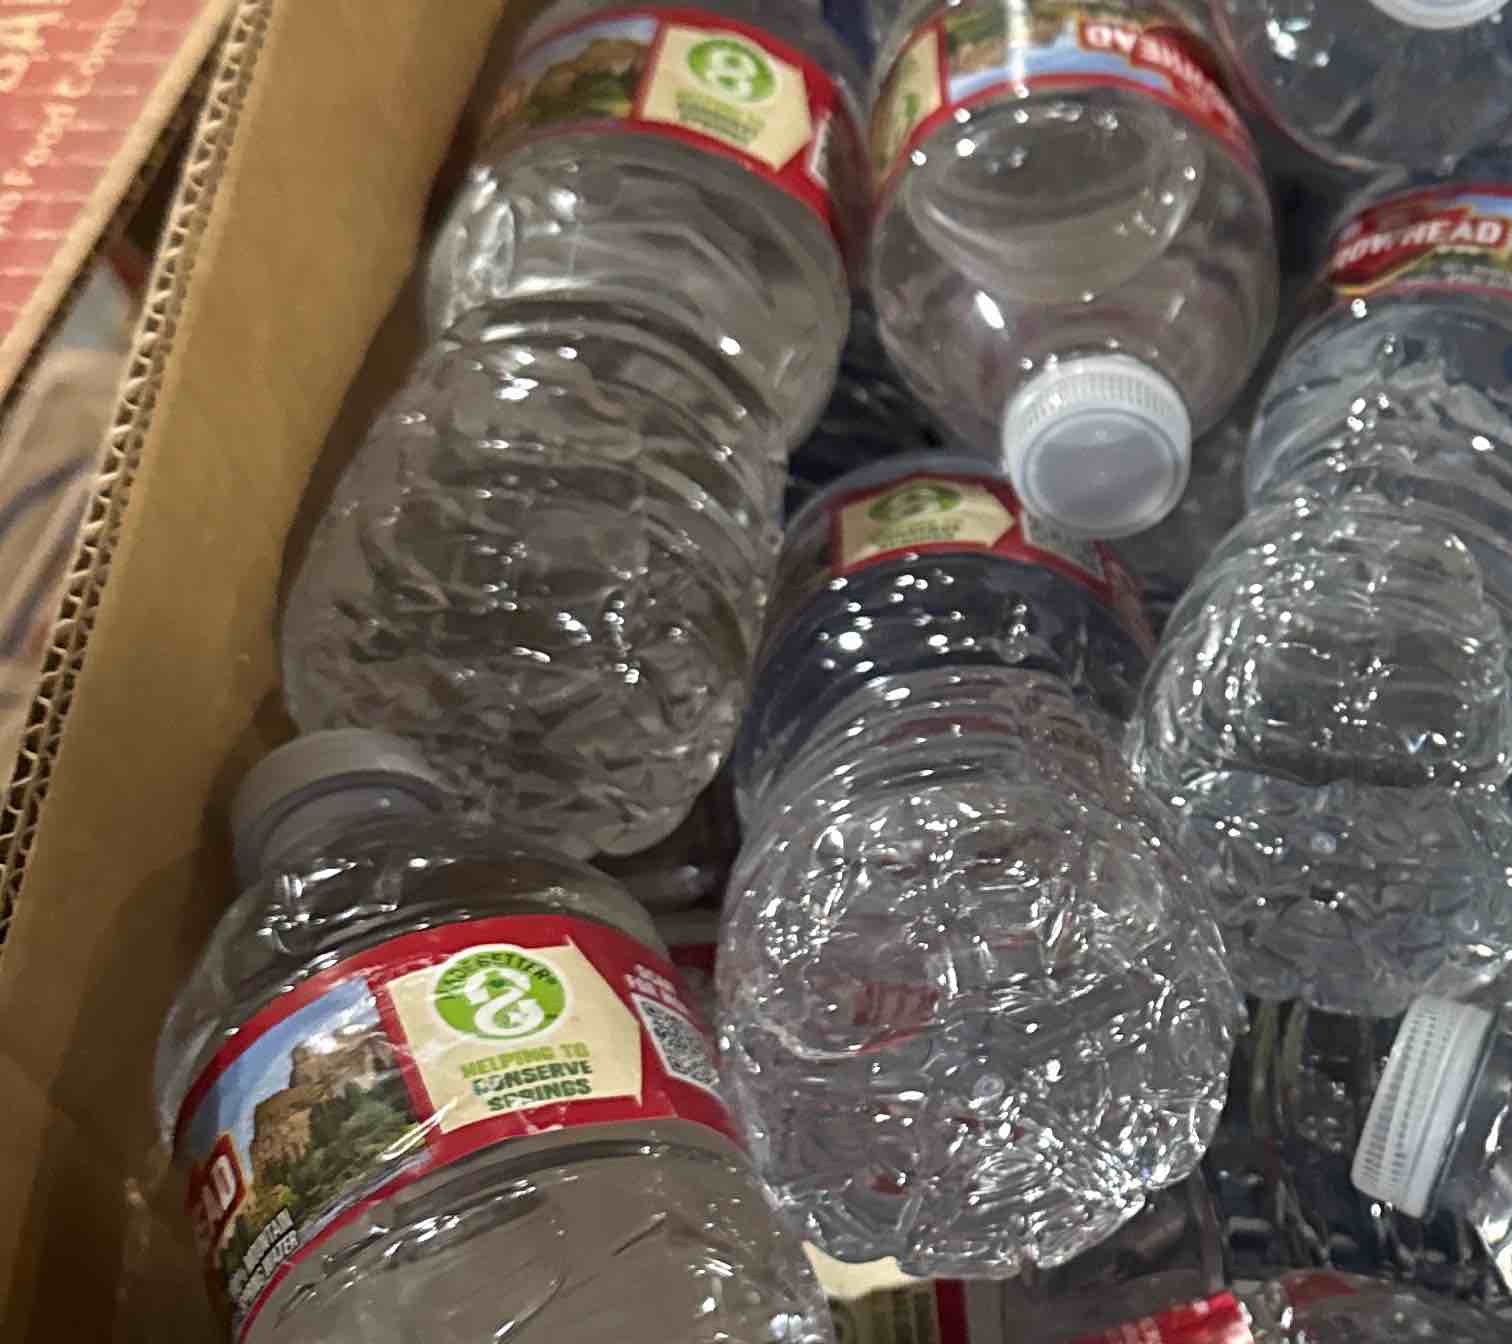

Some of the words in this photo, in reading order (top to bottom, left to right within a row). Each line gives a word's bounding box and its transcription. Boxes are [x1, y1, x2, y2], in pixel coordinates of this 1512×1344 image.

[461, 1045, 555, 1078] HELPING
[560, 1041, 591, 1058] TO
[472, 1059, 593, 1096] CONSERVE
[487, 1078, 593, 1112] SPRINGS
